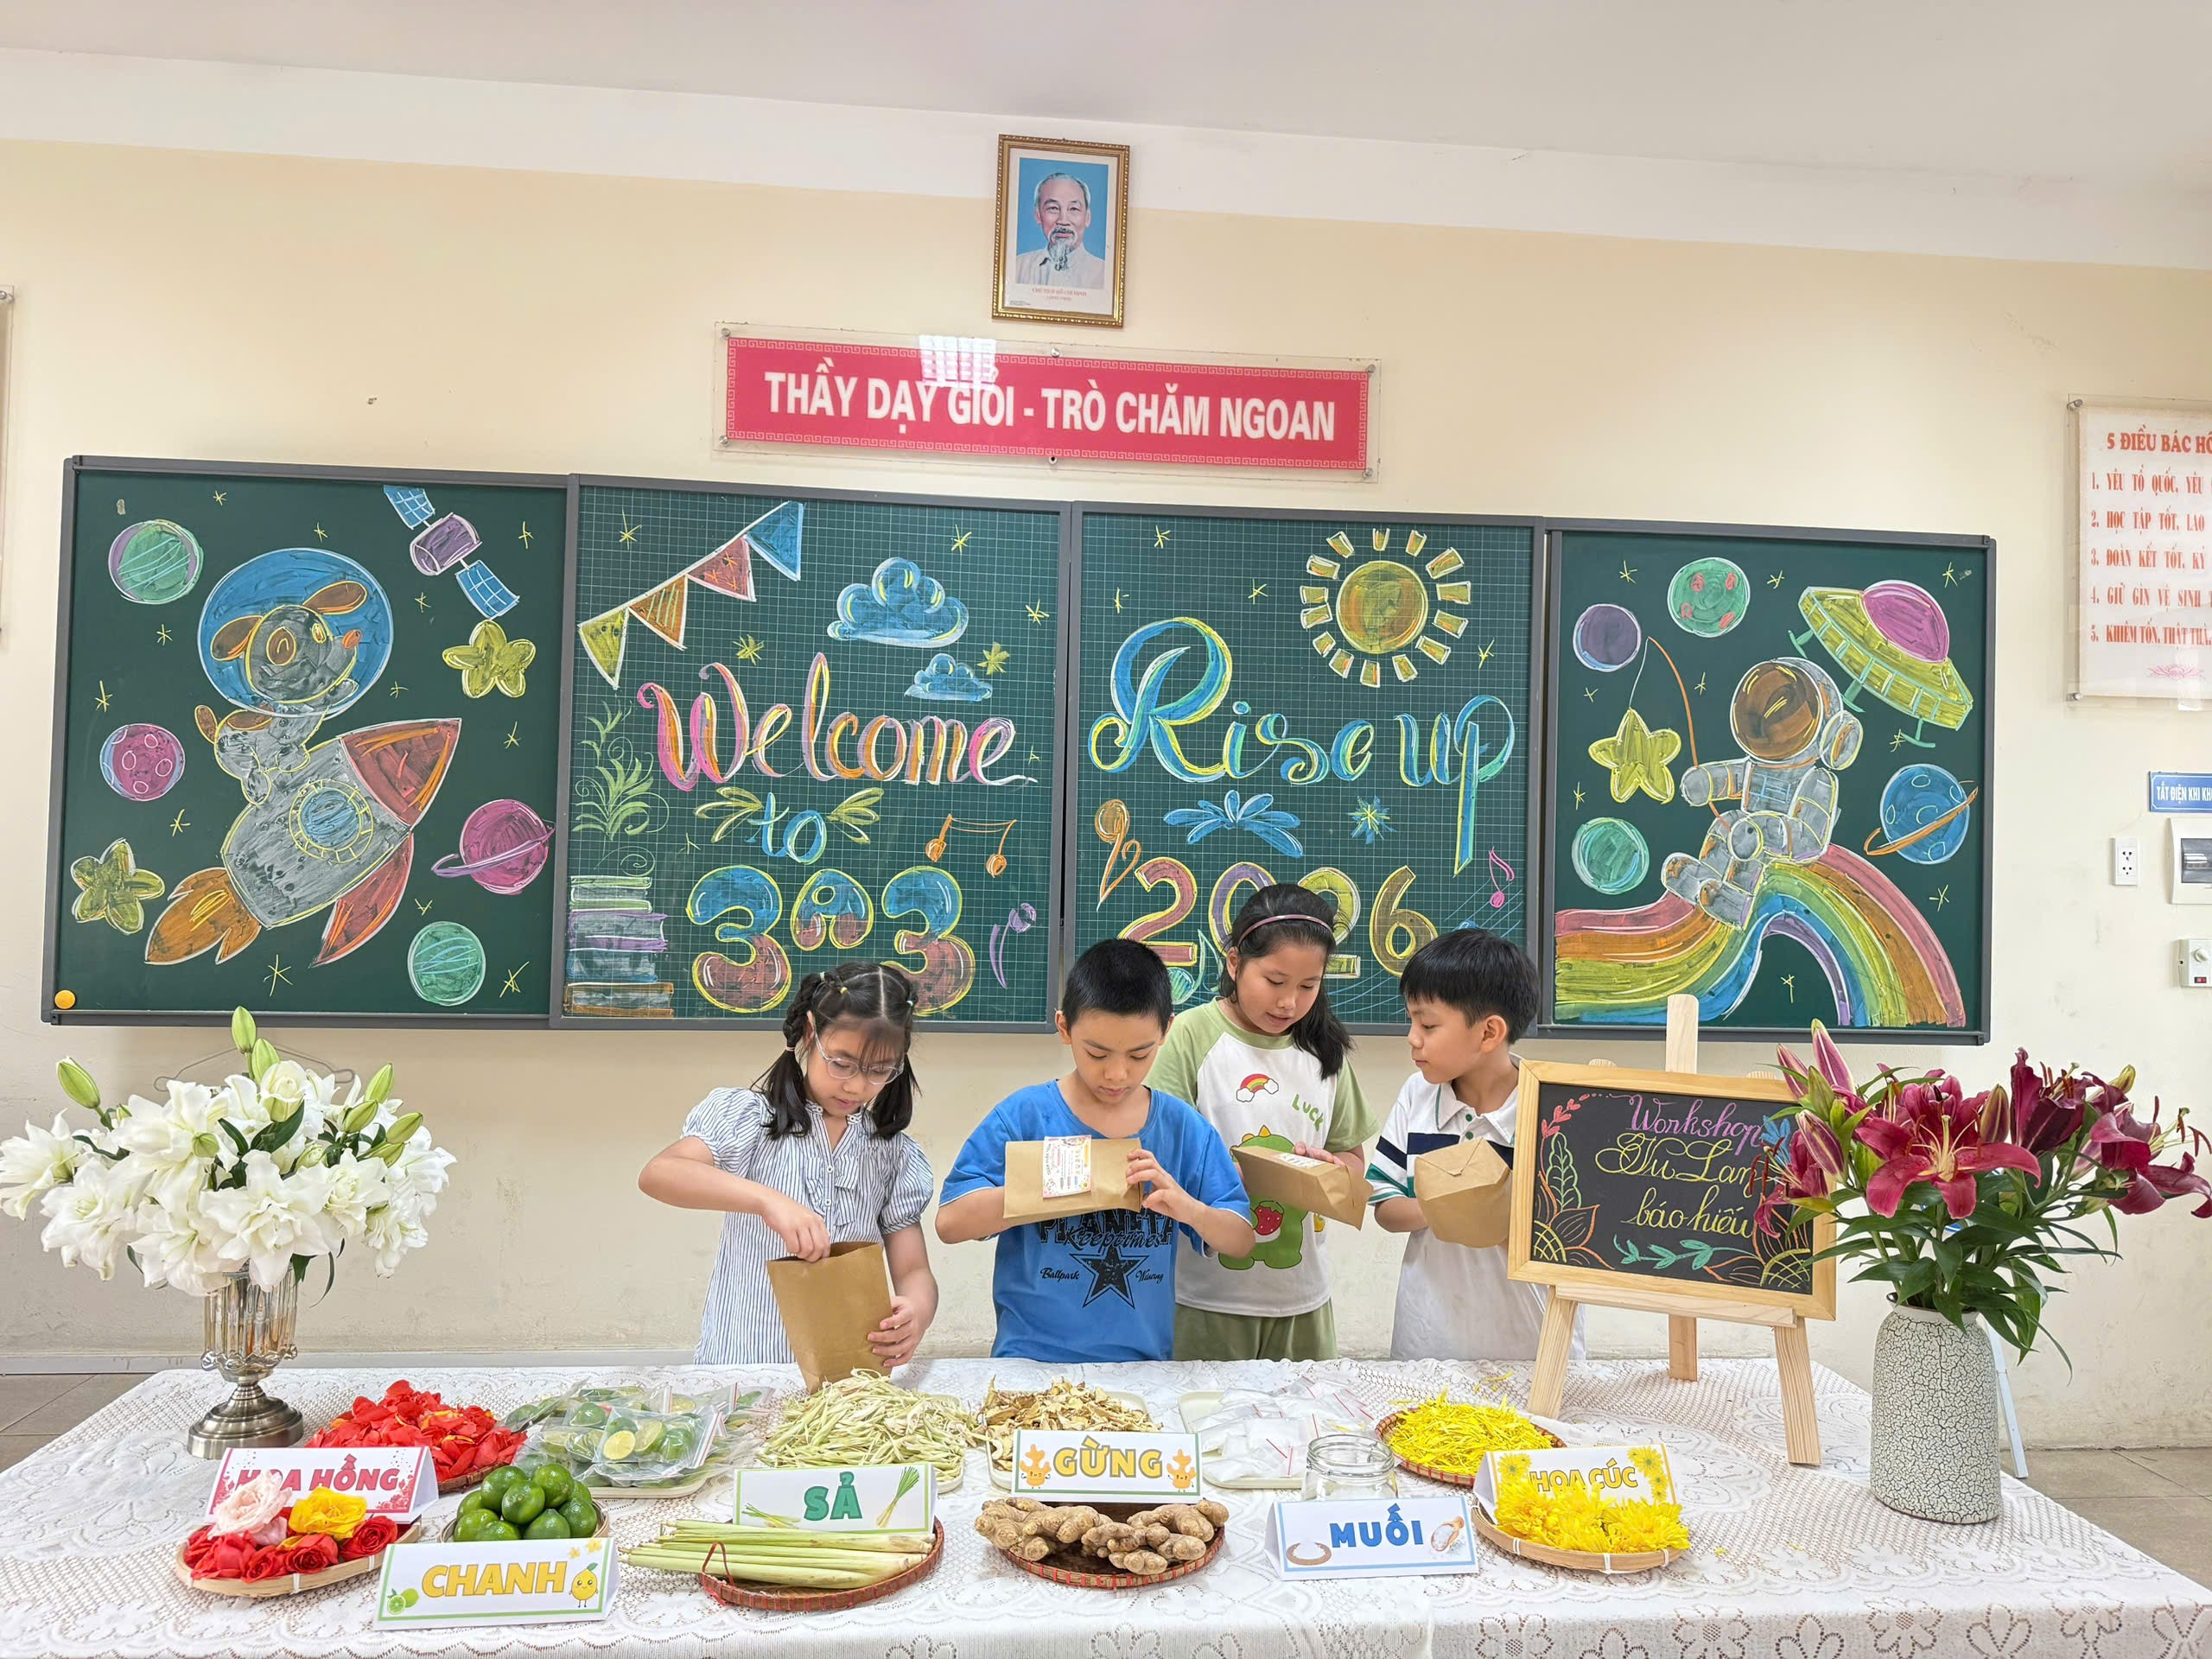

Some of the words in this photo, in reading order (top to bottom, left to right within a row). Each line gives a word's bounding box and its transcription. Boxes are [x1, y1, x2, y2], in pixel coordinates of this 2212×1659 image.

[765, 357, 858, 416] THẦY
[867, 378, 937, 434] DẠY
[948, 366, 1014, 427] GIỎI
[1023, 407, 1035, 417] -
[1040, 378, 1106, 431] TRÒ
[1116, 383, 1210, 436] CHĂM
[1219, 397, 1335, 441] NGOAN
[2107, 432, 2115, 449] 5
[2120, 424, 2157, 451] ĐIỀU
[2161, 429, 2191, 453] BÁC
[2091, 472, 2099, 490] 1.
[2107, 467, 2124, 491] YÊU
[2132, 464, 2145, 492] TỔ
[2186, 471, 2203, 494] YÊU
[2107, 511, 2125, 534] HỌC
[2133, 506, 2151, 535] TẬP
[2186, 513, 2205, 532] LAO
[2091, 548, 2099, 566] 3.
[2106, 543, 2132, 567] ĐOÀN
[2139, 541, 2157, 568] KẾT
[2133, 582, 2150, 606] GÌN
[2158, 584, 2171, 613] VỆ
[2177, 589, 2201, 607] SINH
[2106, 620, 2137, 643] KHIÊM
[2163, 621, 2188, 650] THẬT
[637, 652, 1038, 790] Welcome
[1088, 616, 1376, 785] Rise
[1395, 695, 1515, 878] up
[2170, 784, 2187, 804] ĐIỆN
[2188, 786, 2201, 802] KHI
[747, 792, 827, 863] to
[1118, 856, 1439, 979] 2026
[686, 864, 975, 1016] 3A3
[1610, 1093, 1764, 1156] Workshop
[1675, 1138, 1759, 1198] Lan
[1687, 1184, 1754, 1239] hiếu
[234, 1469, 302, 1491] HA
[309, 1453, 400, 1491] HỒNG
[1053, 1435, 1162, 1478] GỪNG
[1588, 1457, 1638, 1490] CÚC
[804, 1471, 863, 1522] SẢ
[1330, 1503, 1424, 1548] MUỐI
[422, 1560, 568, 1599] CHANH
